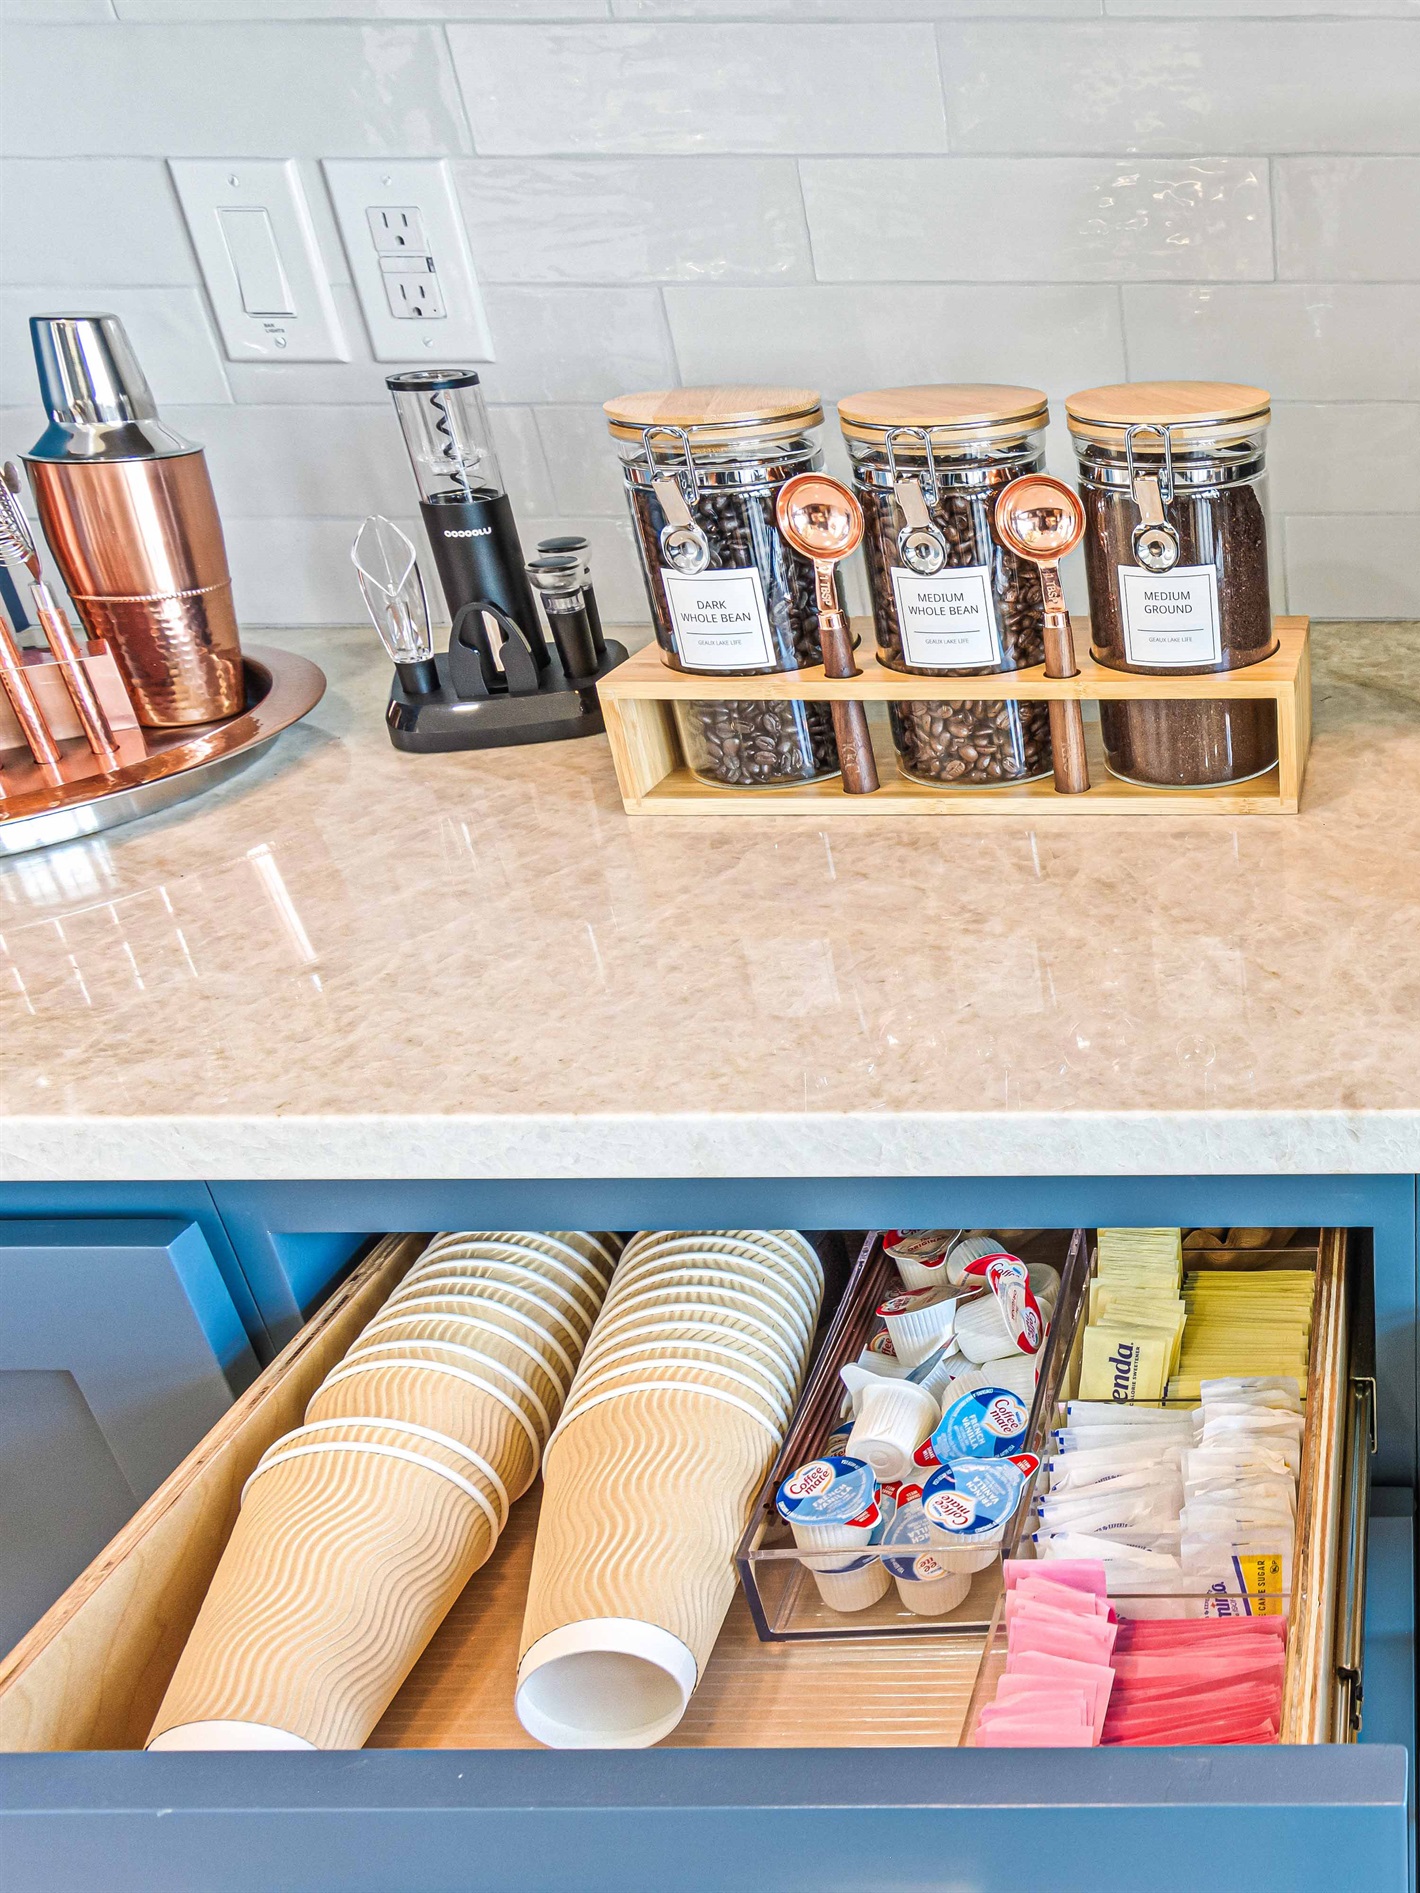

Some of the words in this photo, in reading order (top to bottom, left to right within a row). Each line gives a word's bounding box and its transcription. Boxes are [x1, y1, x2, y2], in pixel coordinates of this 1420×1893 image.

[696, 600, 727, 610] DARK
[819, 580, 832, 607] TBSP
[918, 592, 964, 603] MEDIUM
[1144, 591, 1190, 600] MEDIUM
[681, 612, 718, 623] WHOLE
[721, 612, 752, 622] BEAN
[908, 606, 946, 616] WHOLE
[950, 605, 979, 616] BEAN
[1144, 604, 1193, 614] GROUND
[990, 1410, 1012, 1433] mate
[994, 1399, 1018, 1429] Coffee
[962, 1416, 979, 1450] VANILLA
[969, 1414, 986, 1444] FRENCH
[789, 1467, 823, 1495] Coffee
[805, 1470, 830, 1495] mate
[972, 1476, 1000, 1505] VANILLA
[941, 1495, 971, 1514] mate
[967, 1482, 994, 1508] FRENCH
[934, 1500, 968, 1526] Coffee
[1257, 1560, 1266, 1586] SUGAR
